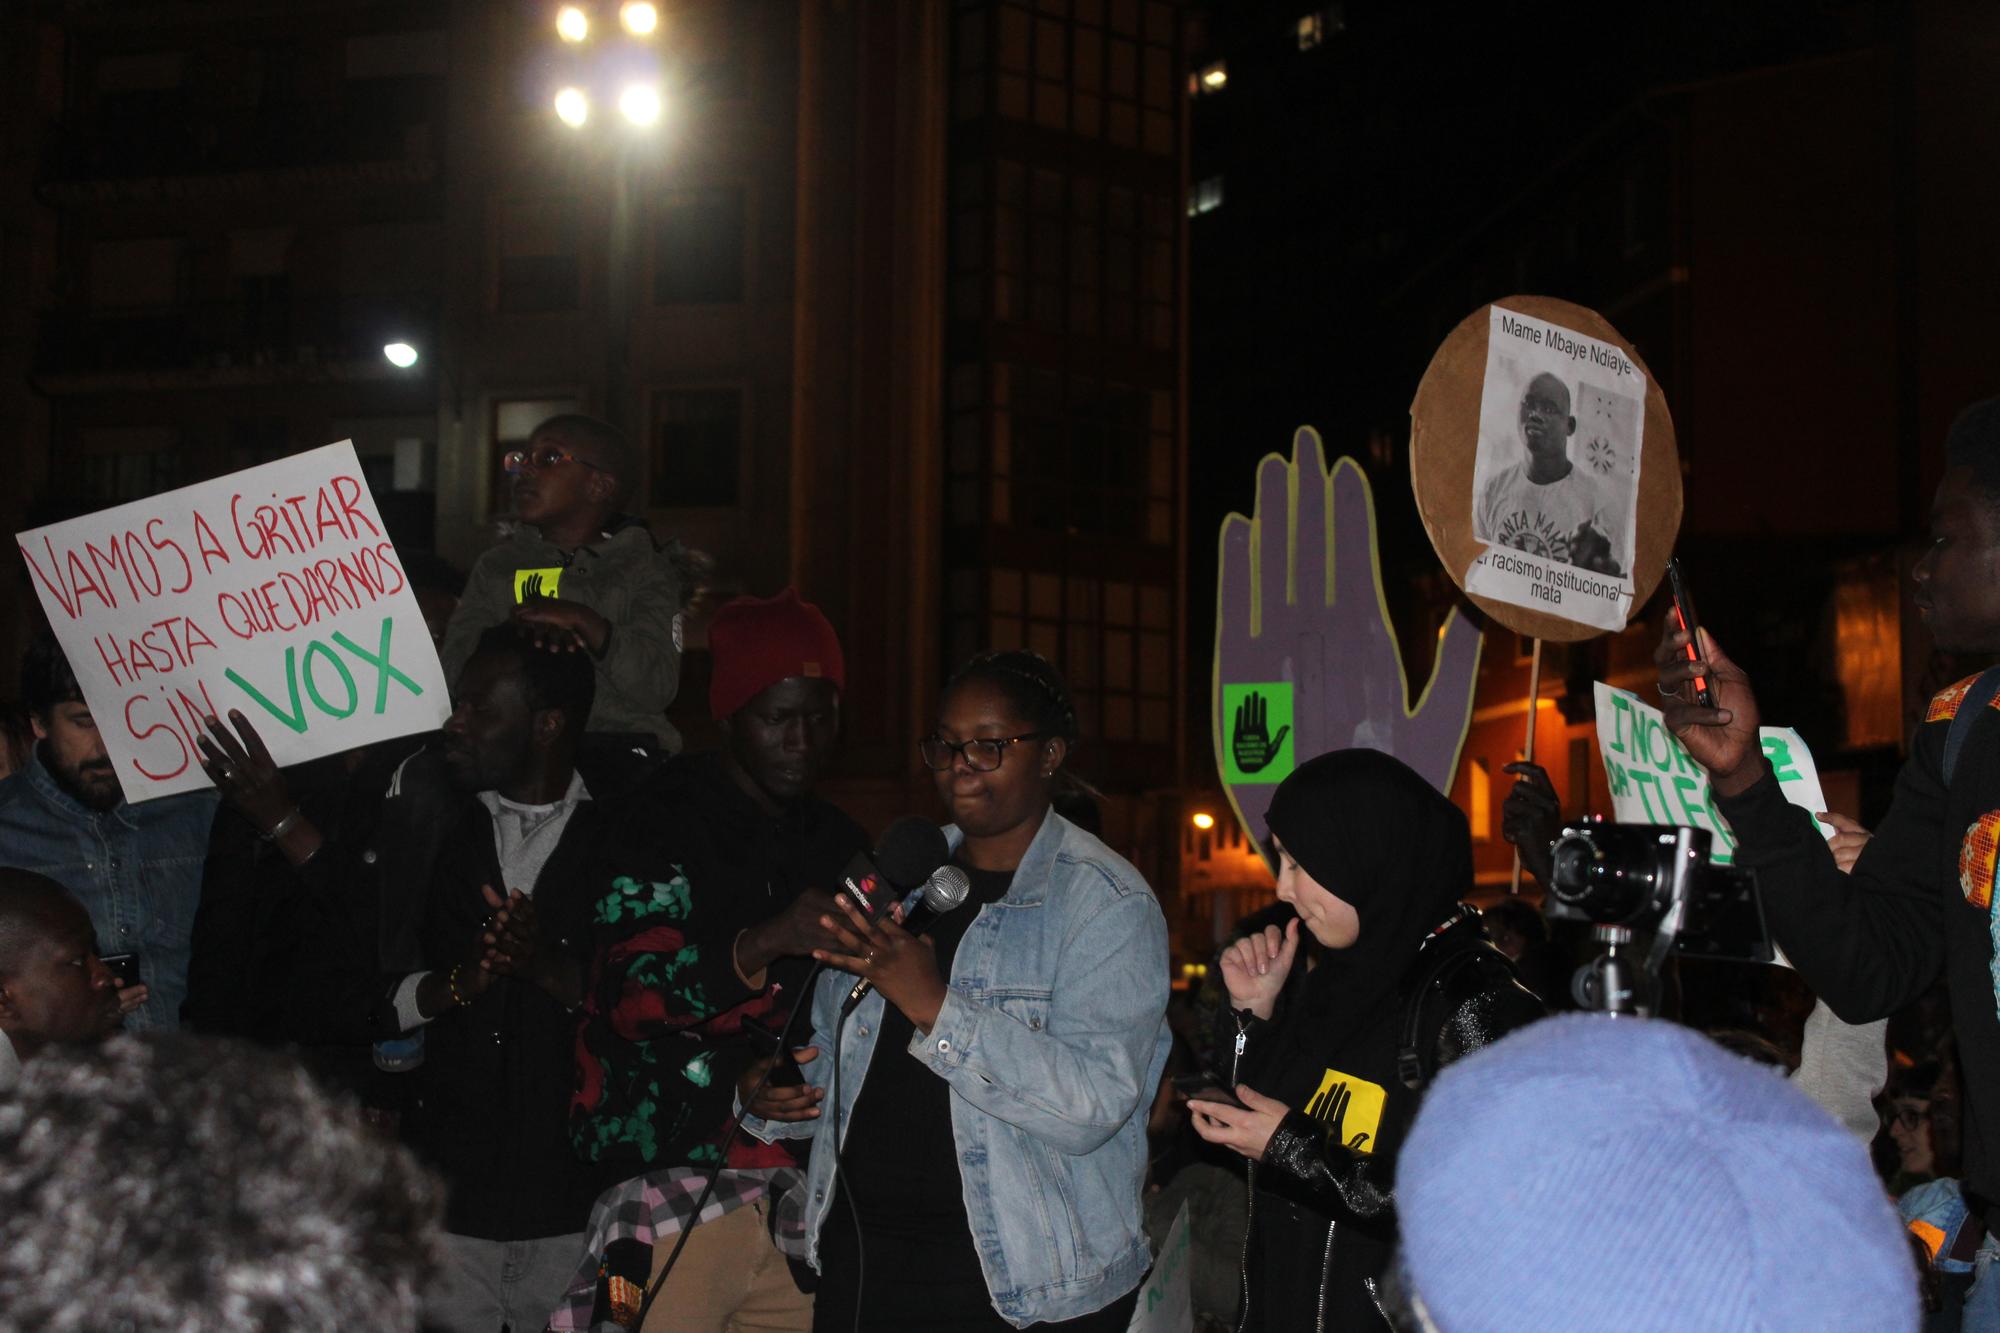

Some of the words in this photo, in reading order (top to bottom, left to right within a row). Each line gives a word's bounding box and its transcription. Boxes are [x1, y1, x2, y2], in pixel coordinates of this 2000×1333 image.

[1502, 315, 1541, 344] Mame
[1545, 328, 1587, 361] Mbaye
[1590, 344, 1632, 377] Ndiaye
[21, 518, 193, 619] VAMOS
[193, 510, 230, 575] A
[1492, 553, 1543, 580] racismo
[1545, 566, 1623, 602] institucional
[1531, 582, 1562, 605] mata
[94, 616, 218, 687] HASTA
[217, 542, 405, 640] QUEDARNOS
[224, 616, 425, 735] VOX
